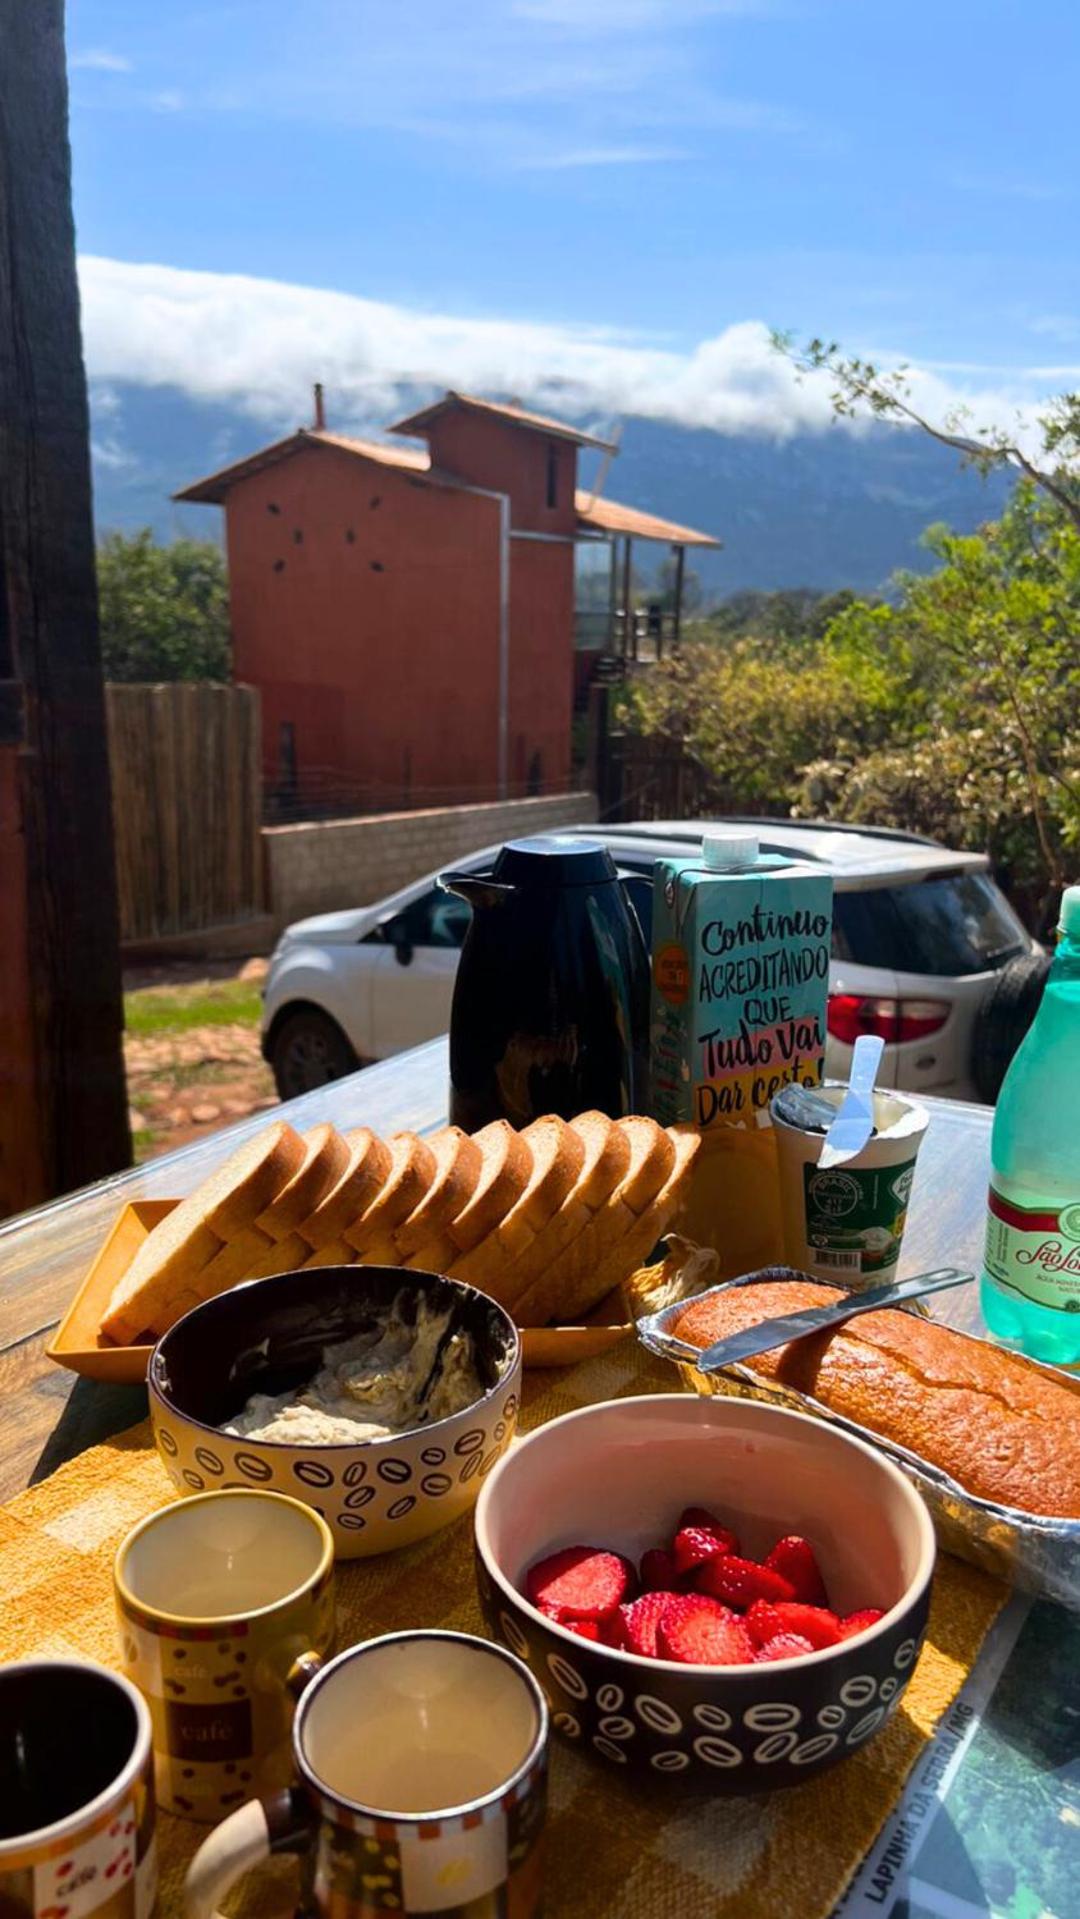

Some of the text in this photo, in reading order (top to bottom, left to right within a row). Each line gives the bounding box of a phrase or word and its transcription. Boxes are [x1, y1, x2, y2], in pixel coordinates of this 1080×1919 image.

[701, 903, 829, 956] Continuo
[699, 945, 829, 1004] ACREDITANDO
[743, 996, 794, 1027] QUE
[697, 1018, 772, 1078] Tudo
[778, 1016, 823, 1053] Vai
[697, 1076, 746, 1126] Dar
[864, 1819, 921, 1904] LAPINHA
[907, 1792, 934, 1823] DA
